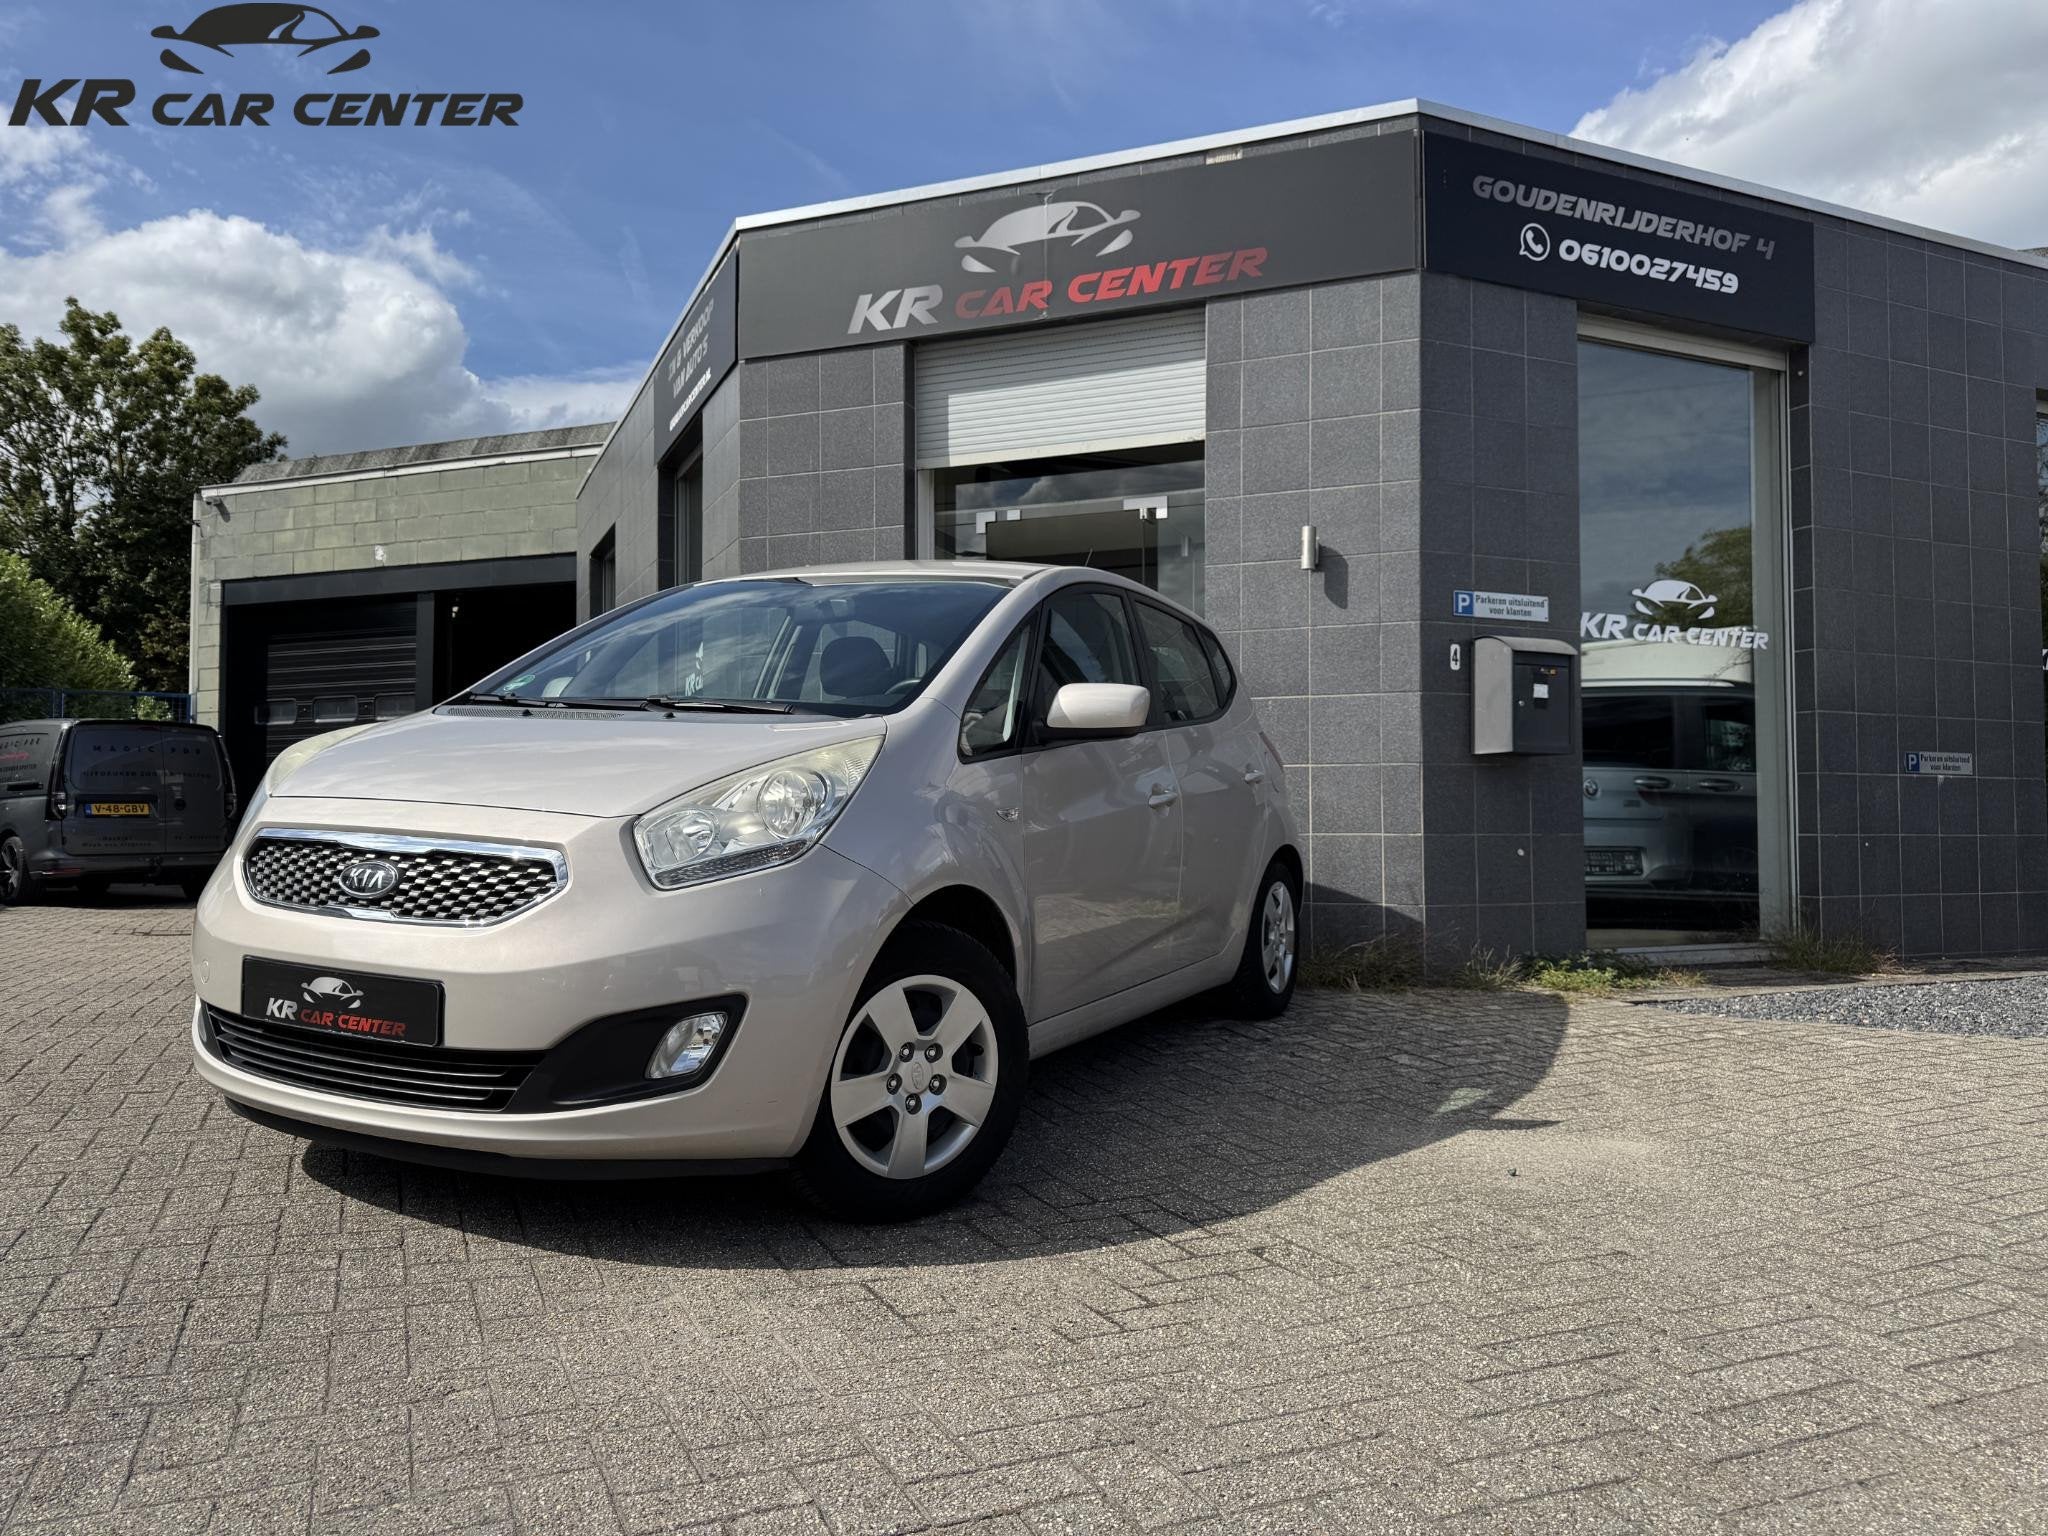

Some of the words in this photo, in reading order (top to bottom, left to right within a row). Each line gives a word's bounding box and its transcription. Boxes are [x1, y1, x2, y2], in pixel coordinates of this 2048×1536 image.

[1472, 175, 1751, 253] GOUDENRIJDERHOF
[1756, 238, 1776, 260] 4
[1558, 239, 1739, 294] 0610027459
[847, 284, 943, 335] KR
[954, 280, 1054, 319] CAR
[1067, 247, 1269, 304] CENTER
[1457, 594, 1471, 613] P
[1475, 594, 1507, 605] Parkeren
[1508, 597, 1545, 609] uitsluitend
[1489, 607, 1505, 615] voor
[1506, 607, 1532, 617] klanten
[1581, 612, 1628, 640] KR
[1632, 623, 1681, 643] CAR
[1686, 627, 1769, 650] CENTER
[1452, 647, 1460, 665] 4
[94, 804, 145, 813] V-48-GBV
[350, 870, 384, 889] KIA
[266, 997, 298, 1021] KR
[300, 1008, 334, 1027] CAR
[337, 1014, 406, 1037] CENTER
